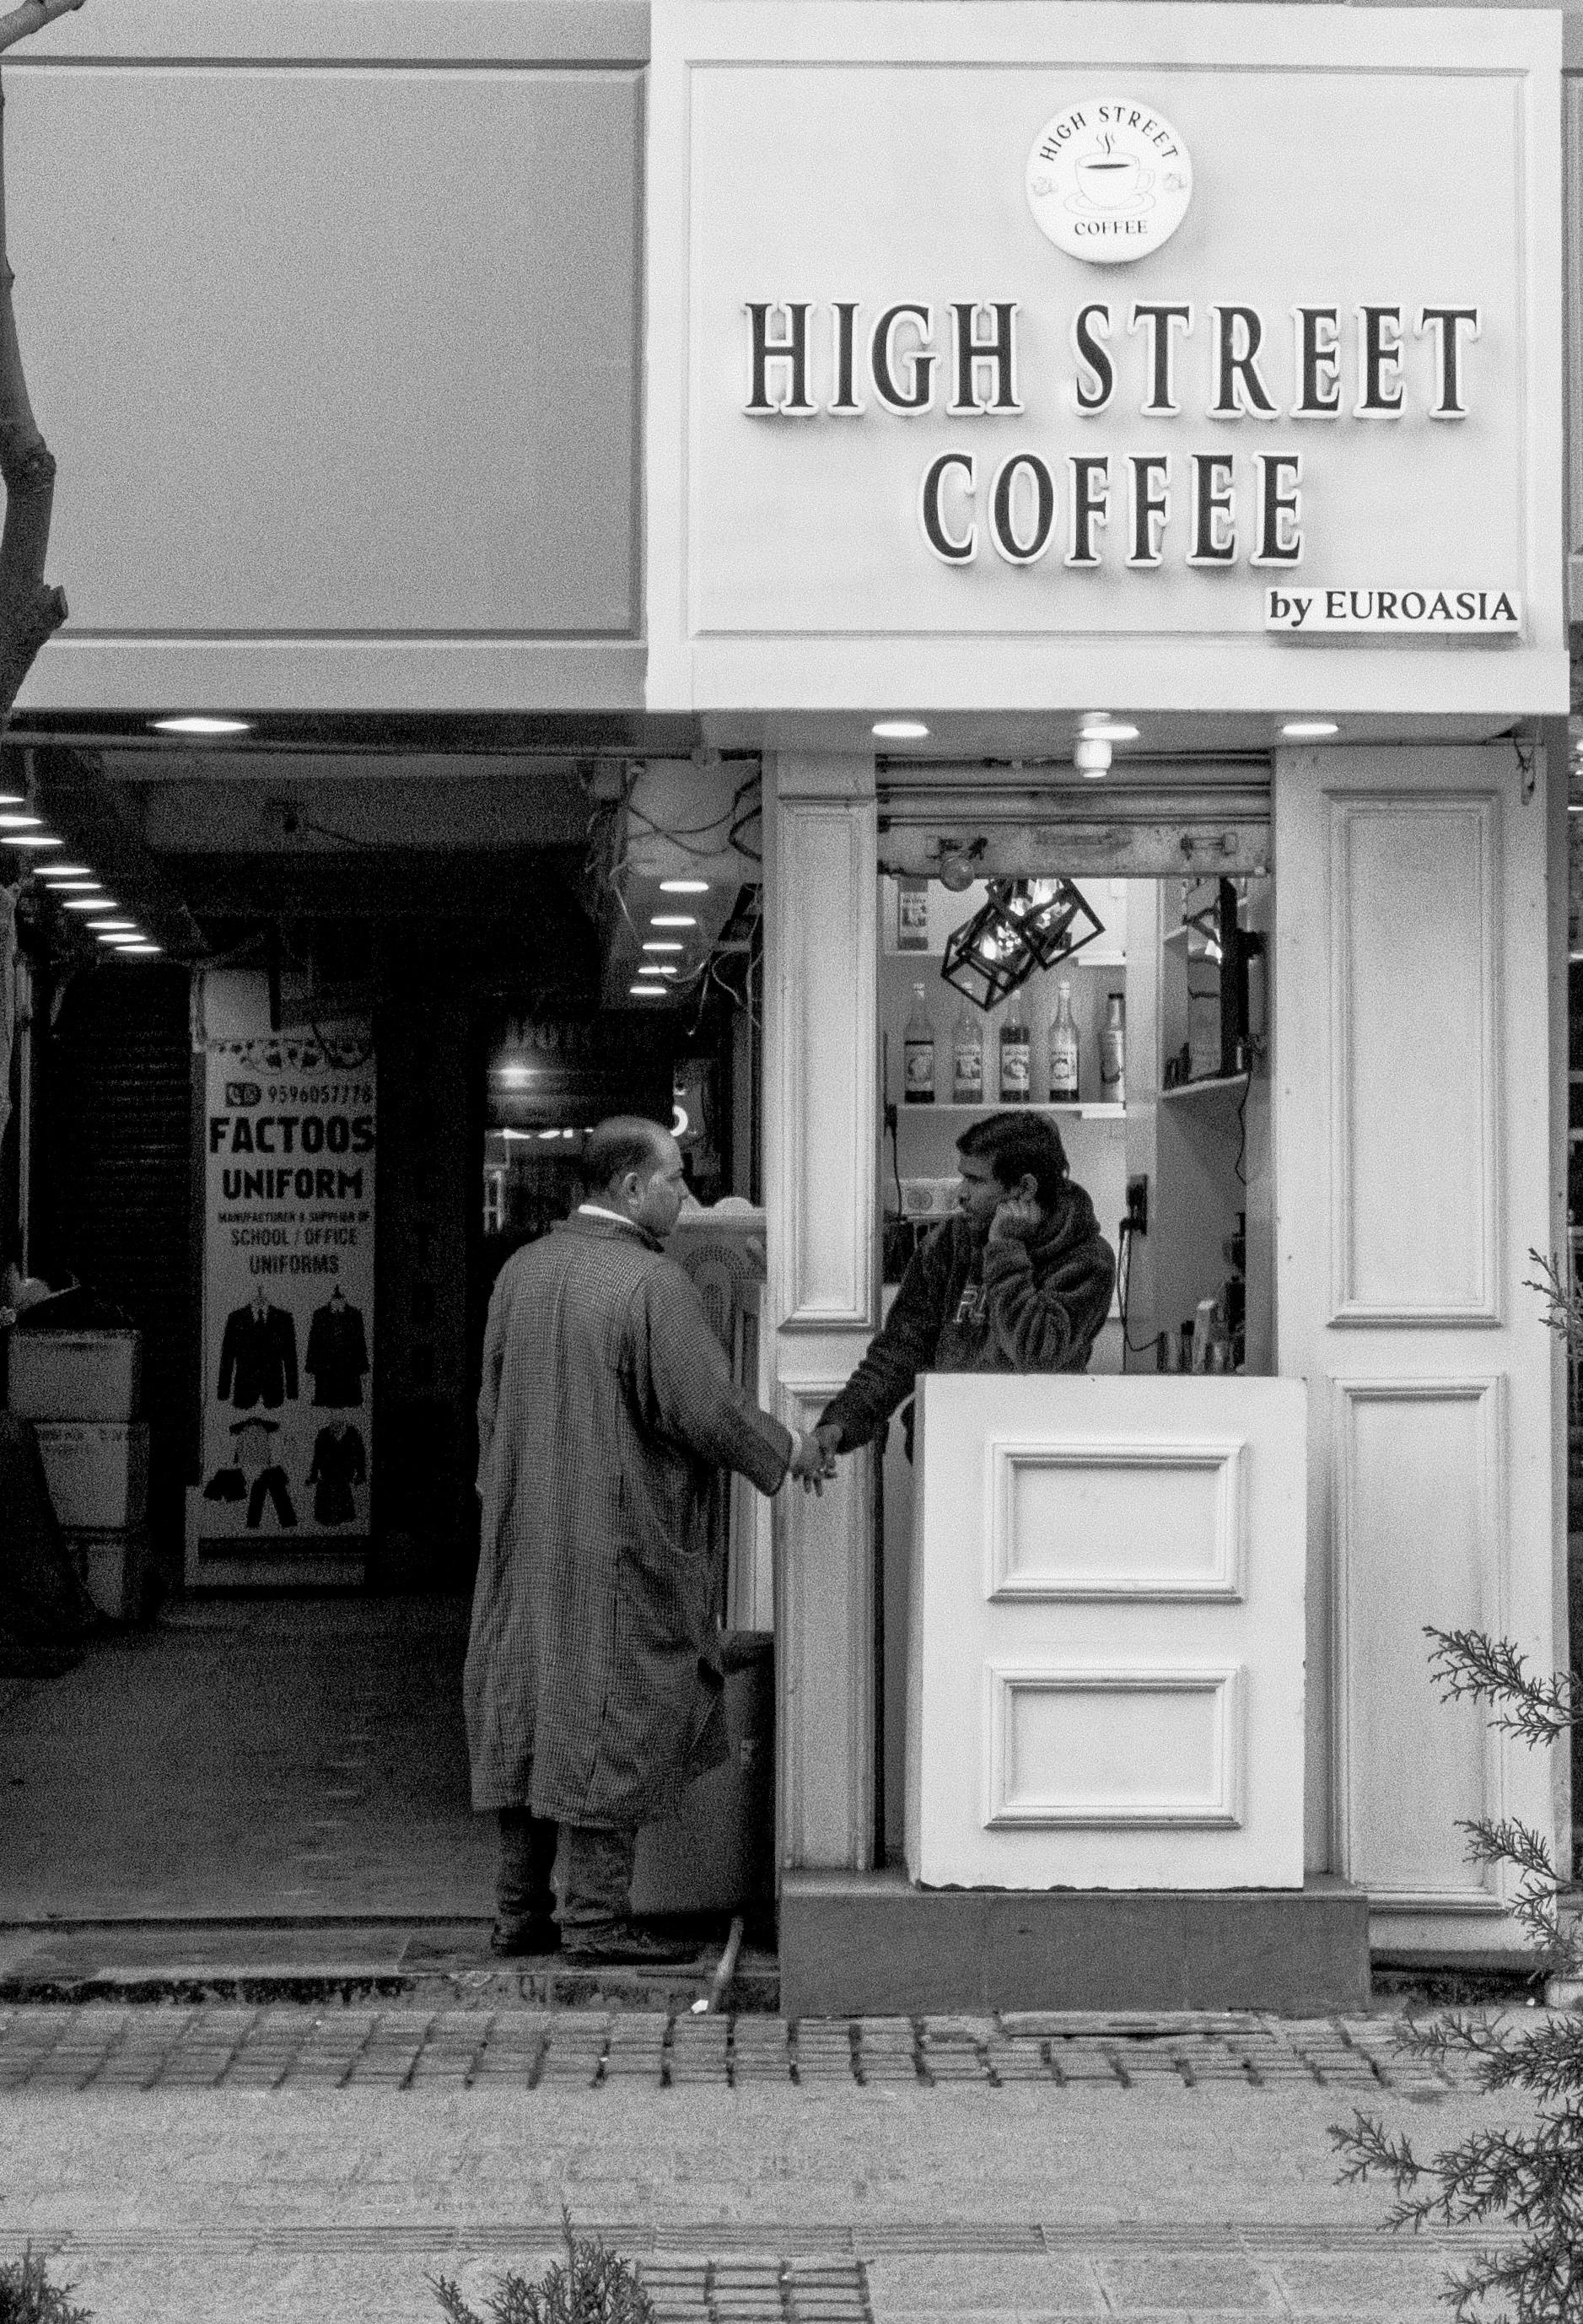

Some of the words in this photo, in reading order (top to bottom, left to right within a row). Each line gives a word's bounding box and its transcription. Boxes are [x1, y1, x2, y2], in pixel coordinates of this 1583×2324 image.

[1040, 112, 1086, 161] HIGH
[1099, 106, 1178, 158] STREET
[1074, 220, 1148, 235] COFFEE
[743, 301, 1022, 412] HIGH
[1074, 304, 1478, 416] STREET
[921, 452, 1302, 563] COFFEE
[1269, 590, 1312, 627] by
[1325, 590, 1518, 620] EUROASIA
[210, 1115, 375, 1153] FACTOOS
[222, 1167, 363, 1200] UNIFORM
[231, 1228, 289, 1246] SCHOOL
[304, 1227, 358, 1245] OFFICE
[250, 1254, 339, 1275] UNIFORMS
